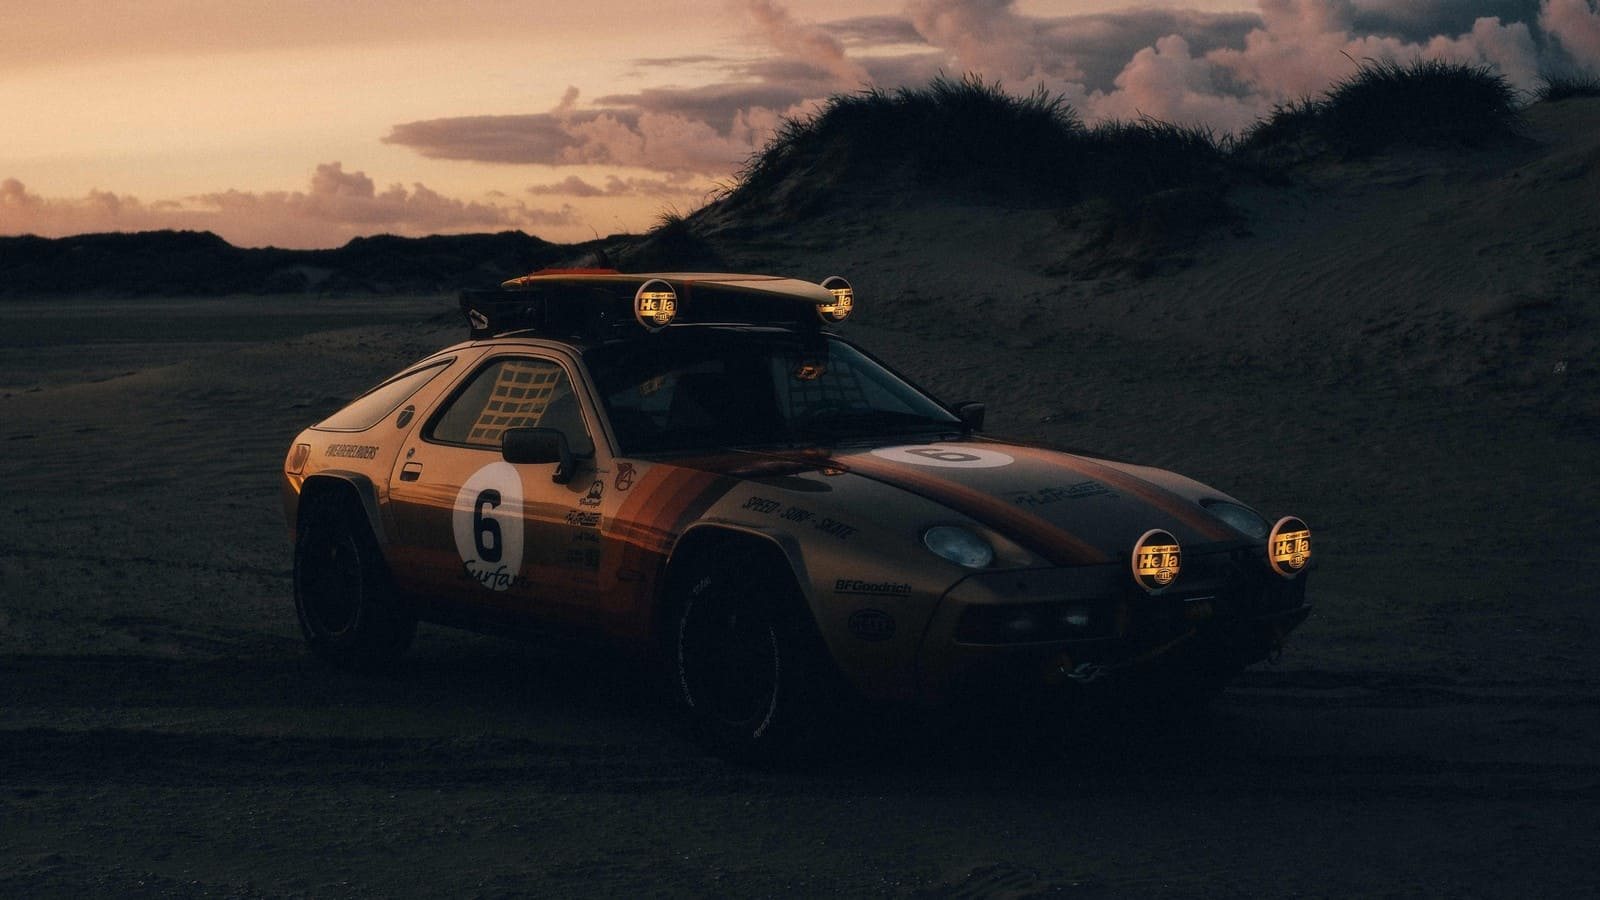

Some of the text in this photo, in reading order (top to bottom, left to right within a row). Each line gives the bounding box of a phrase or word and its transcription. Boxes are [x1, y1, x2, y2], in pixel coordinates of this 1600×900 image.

[640, 299, 674, 311] Hella
[903, 448, 982, 462] 6
[474, 488, 502, 562] 6
[742, 496, 857, 540] SPEED SURF SKATE
[1275, 539, 1309, 555] Hella
[1139, 553, 1178, 569] Hella
[835, 580, 912, 594] BFGoodrich
